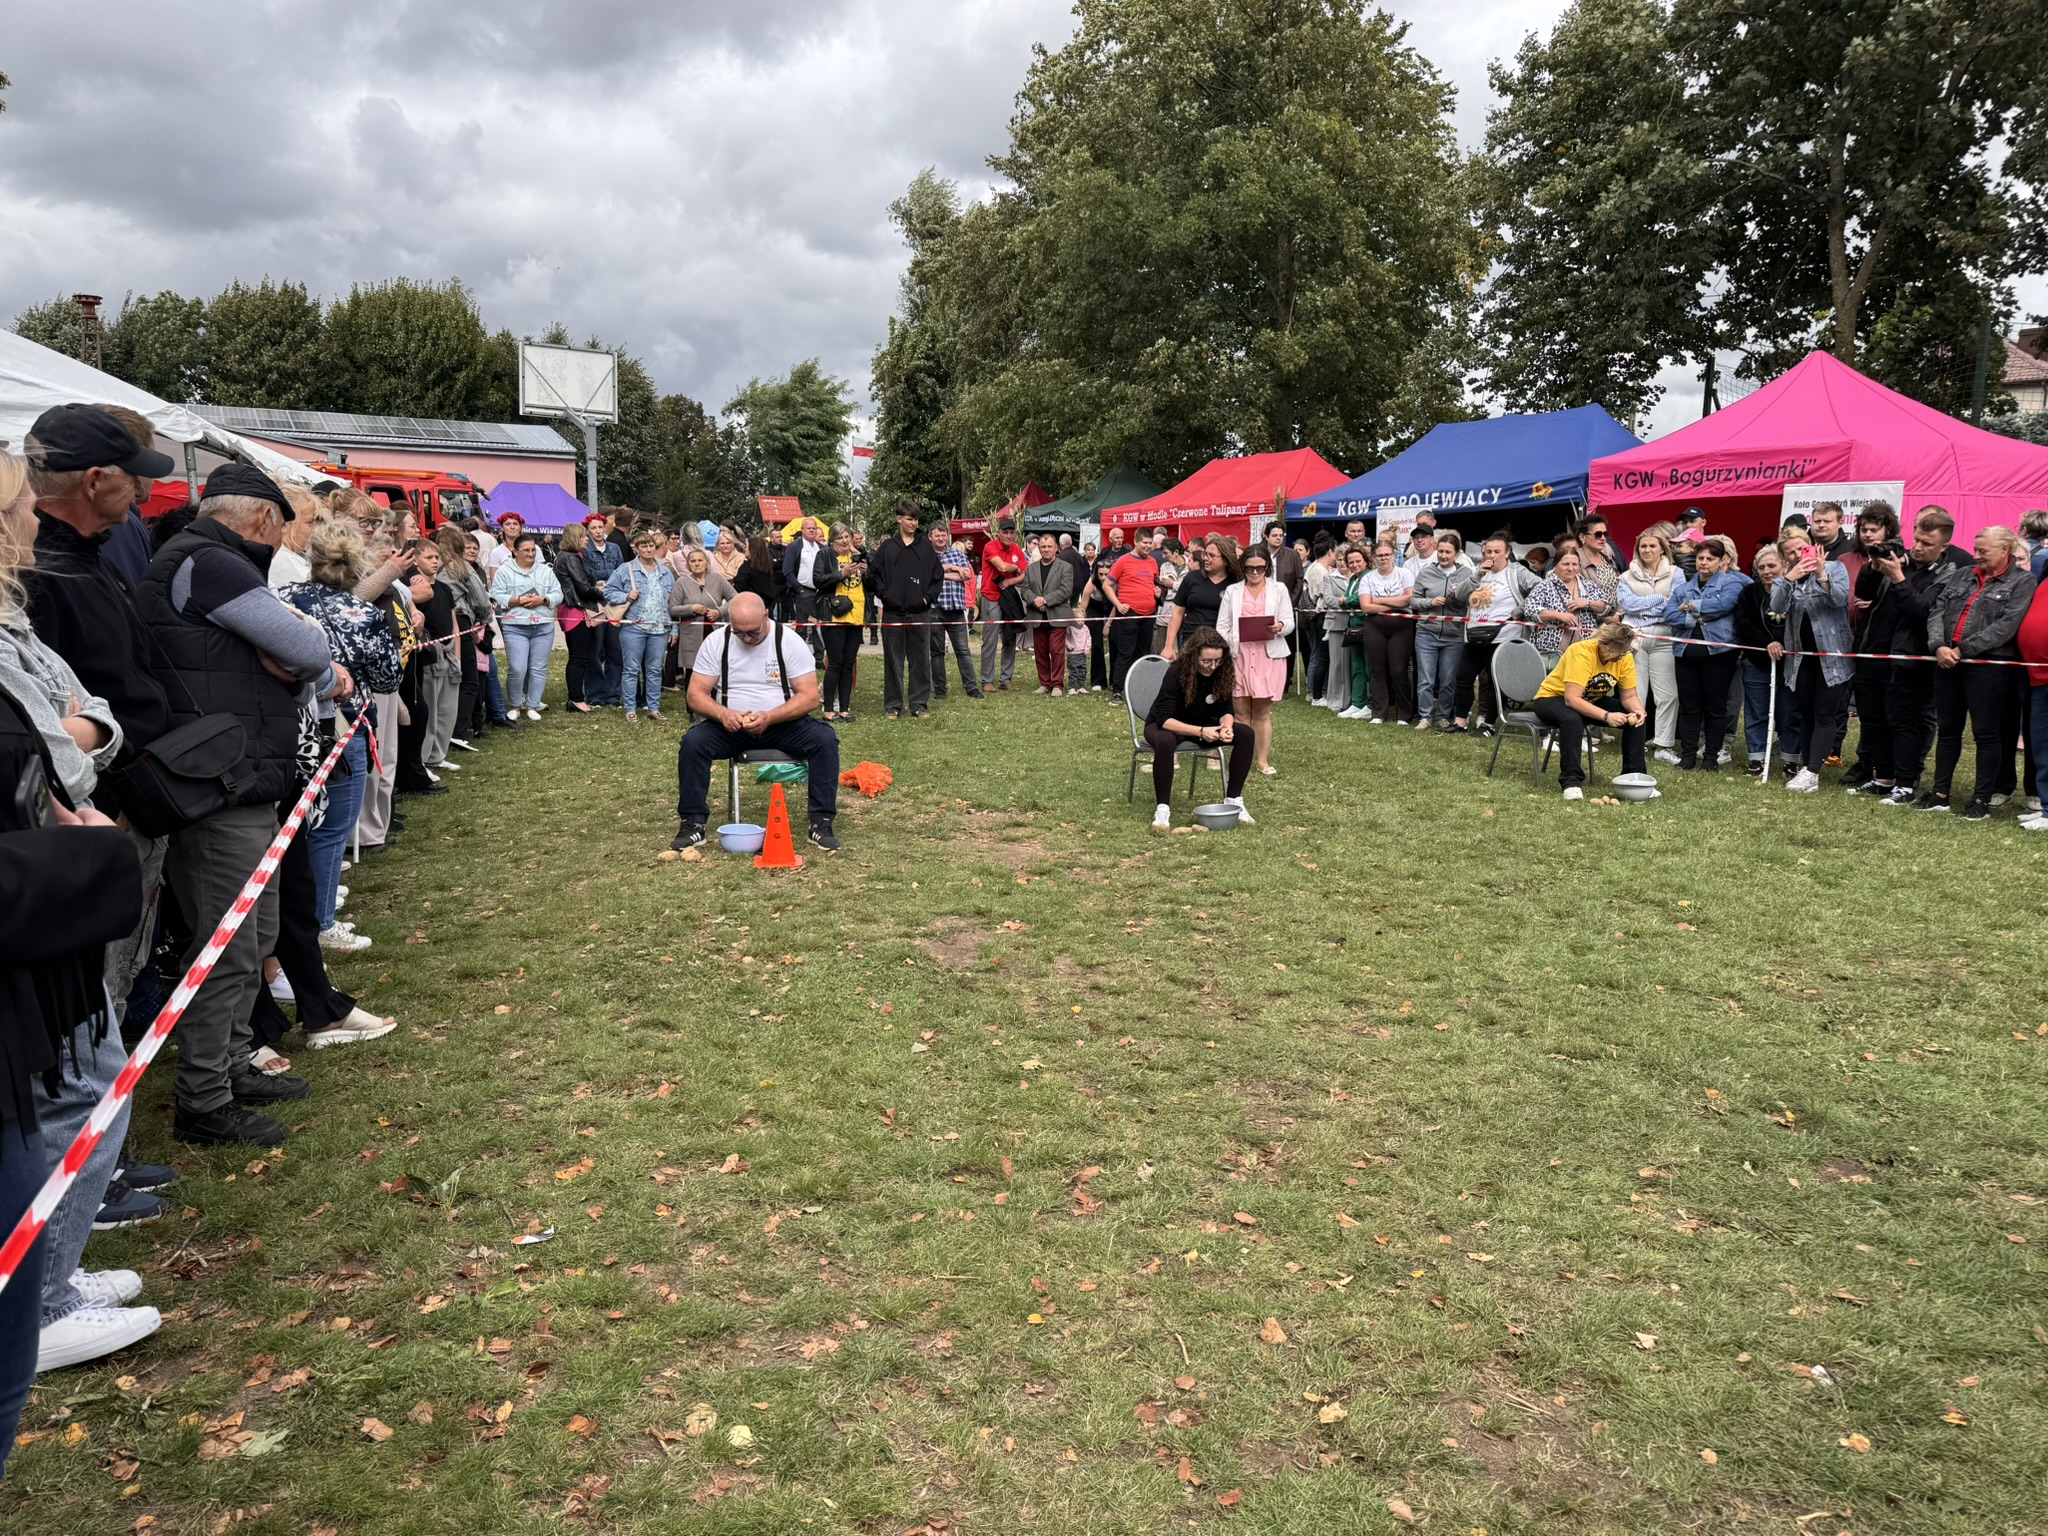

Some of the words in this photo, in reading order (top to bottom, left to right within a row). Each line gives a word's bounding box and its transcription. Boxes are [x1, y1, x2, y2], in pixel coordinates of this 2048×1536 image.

[1614, 470, 1655, 490] KGW
[1123, 511, 1140, 523] KGW
[1140, 514, 1147, 522] w
[1210, 500, 1251, 518] Tulipany"
[1337, 499, 1371, 516] KGW
